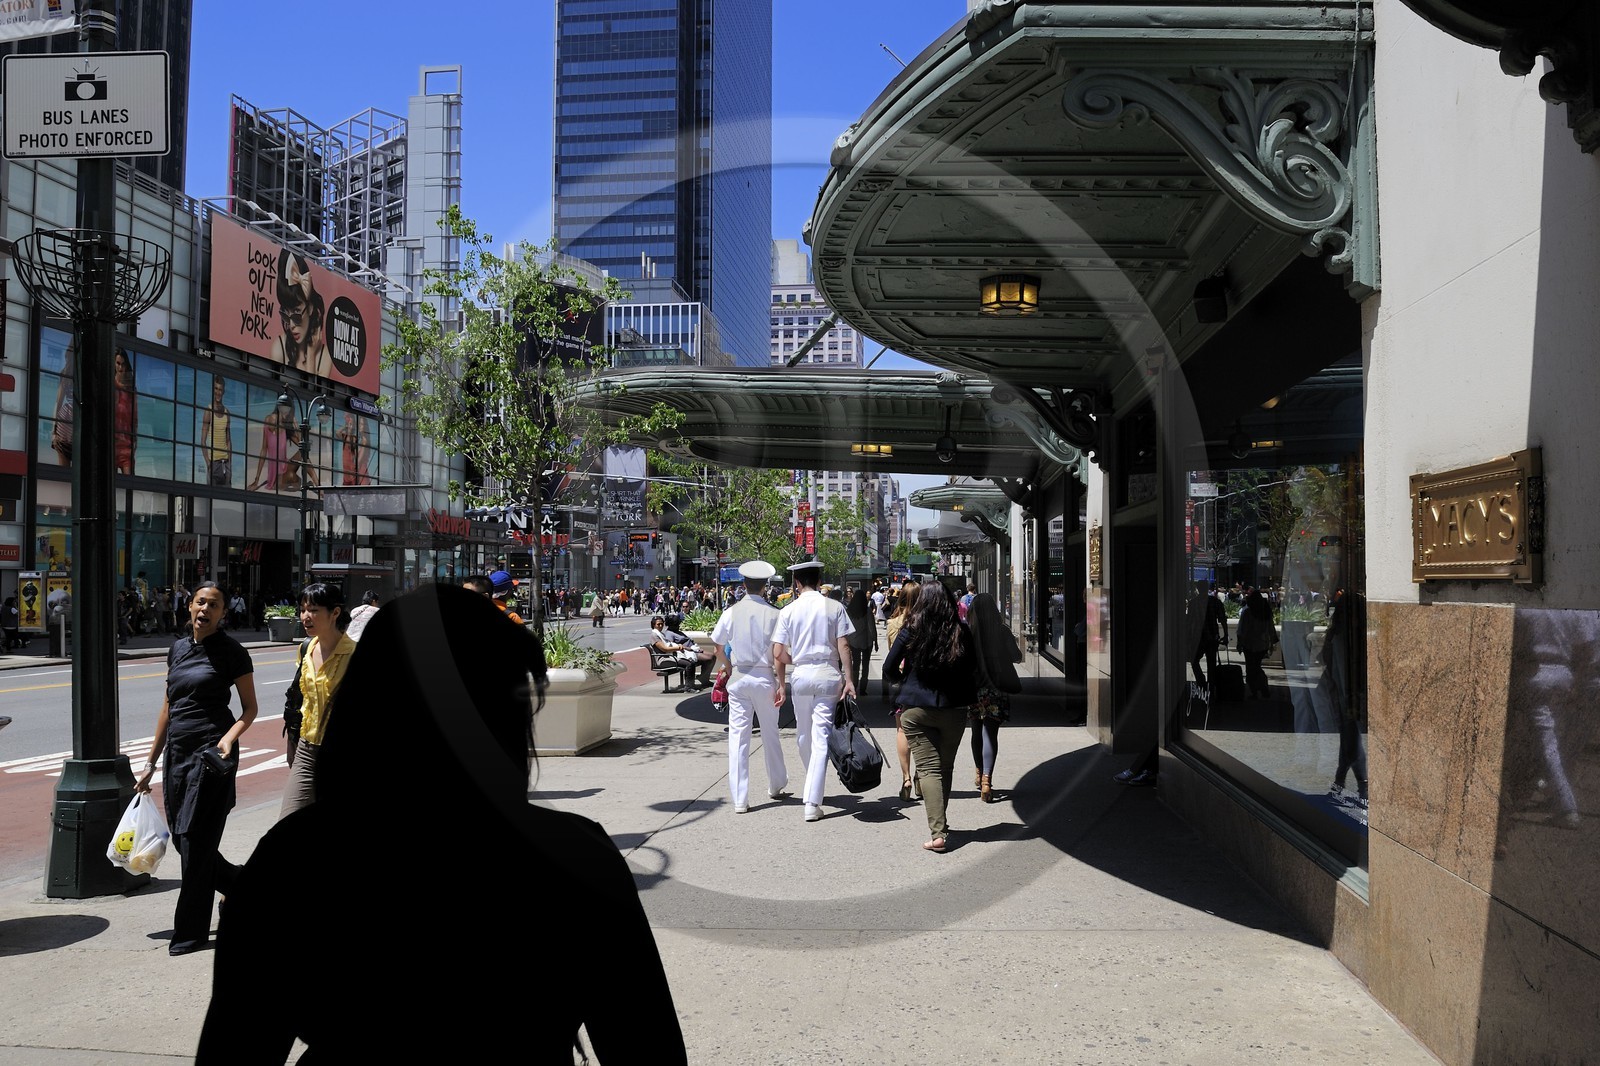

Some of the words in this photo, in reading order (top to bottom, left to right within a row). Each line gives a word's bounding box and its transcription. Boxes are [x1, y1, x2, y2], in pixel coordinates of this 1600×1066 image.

[43, 111, 73, 125] BUS
[81, 109, 129, 124] LANES
[19, 133, 69, 148] PHOTO
[76, 131, 153, 147] ENFORCED
[248, 242, 277, 274] LOOK
[249, 268, 276, 295] OUT
[251, 291, 274, 318] NEW
[240, 309, 271, 340] YORK.
[333, 318, 350, 342] NOW
[351, 325, 360, 346] AT
[333, 339, 359, 367] MACY'S
[565, 342, 580, 350] game
[429, 507, 472, 540] Subway
[1430, 492, 1517, 548] MACY'S
[175, 539, 197, 555] H&M
